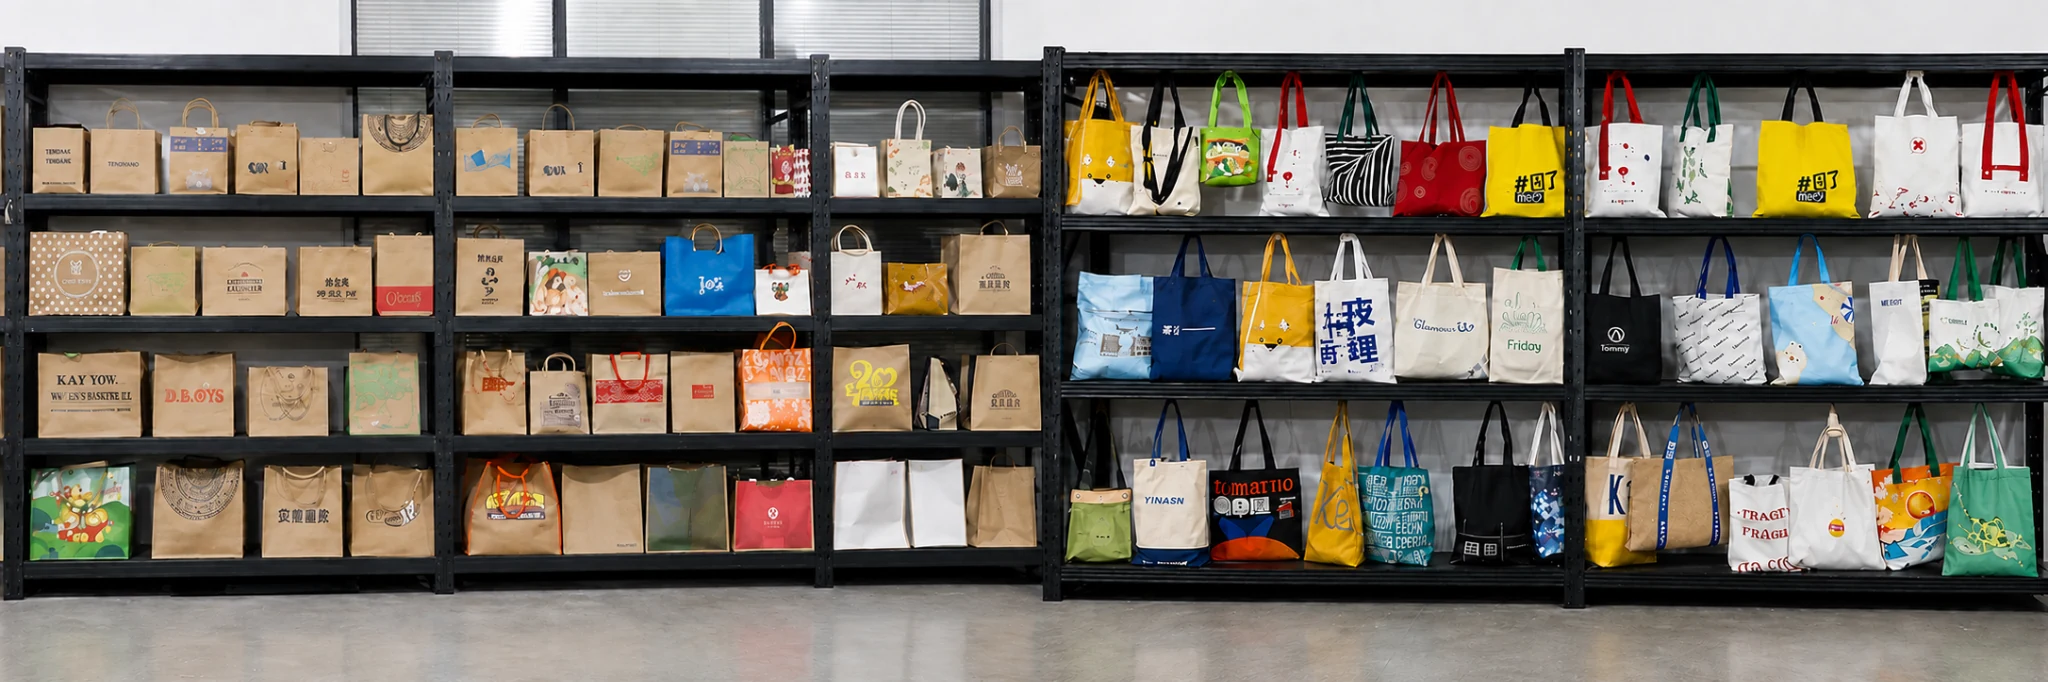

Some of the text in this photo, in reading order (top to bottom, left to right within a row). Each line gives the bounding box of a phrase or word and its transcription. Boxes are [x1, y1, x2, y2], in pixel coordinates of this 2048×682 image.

[1507, 339, 1541, 353] Friday
[1600, 344, 1630, 354] Tommy
[57, 375, 86, 386] KAY
[1144, 496, 1185, 505] YINASN
